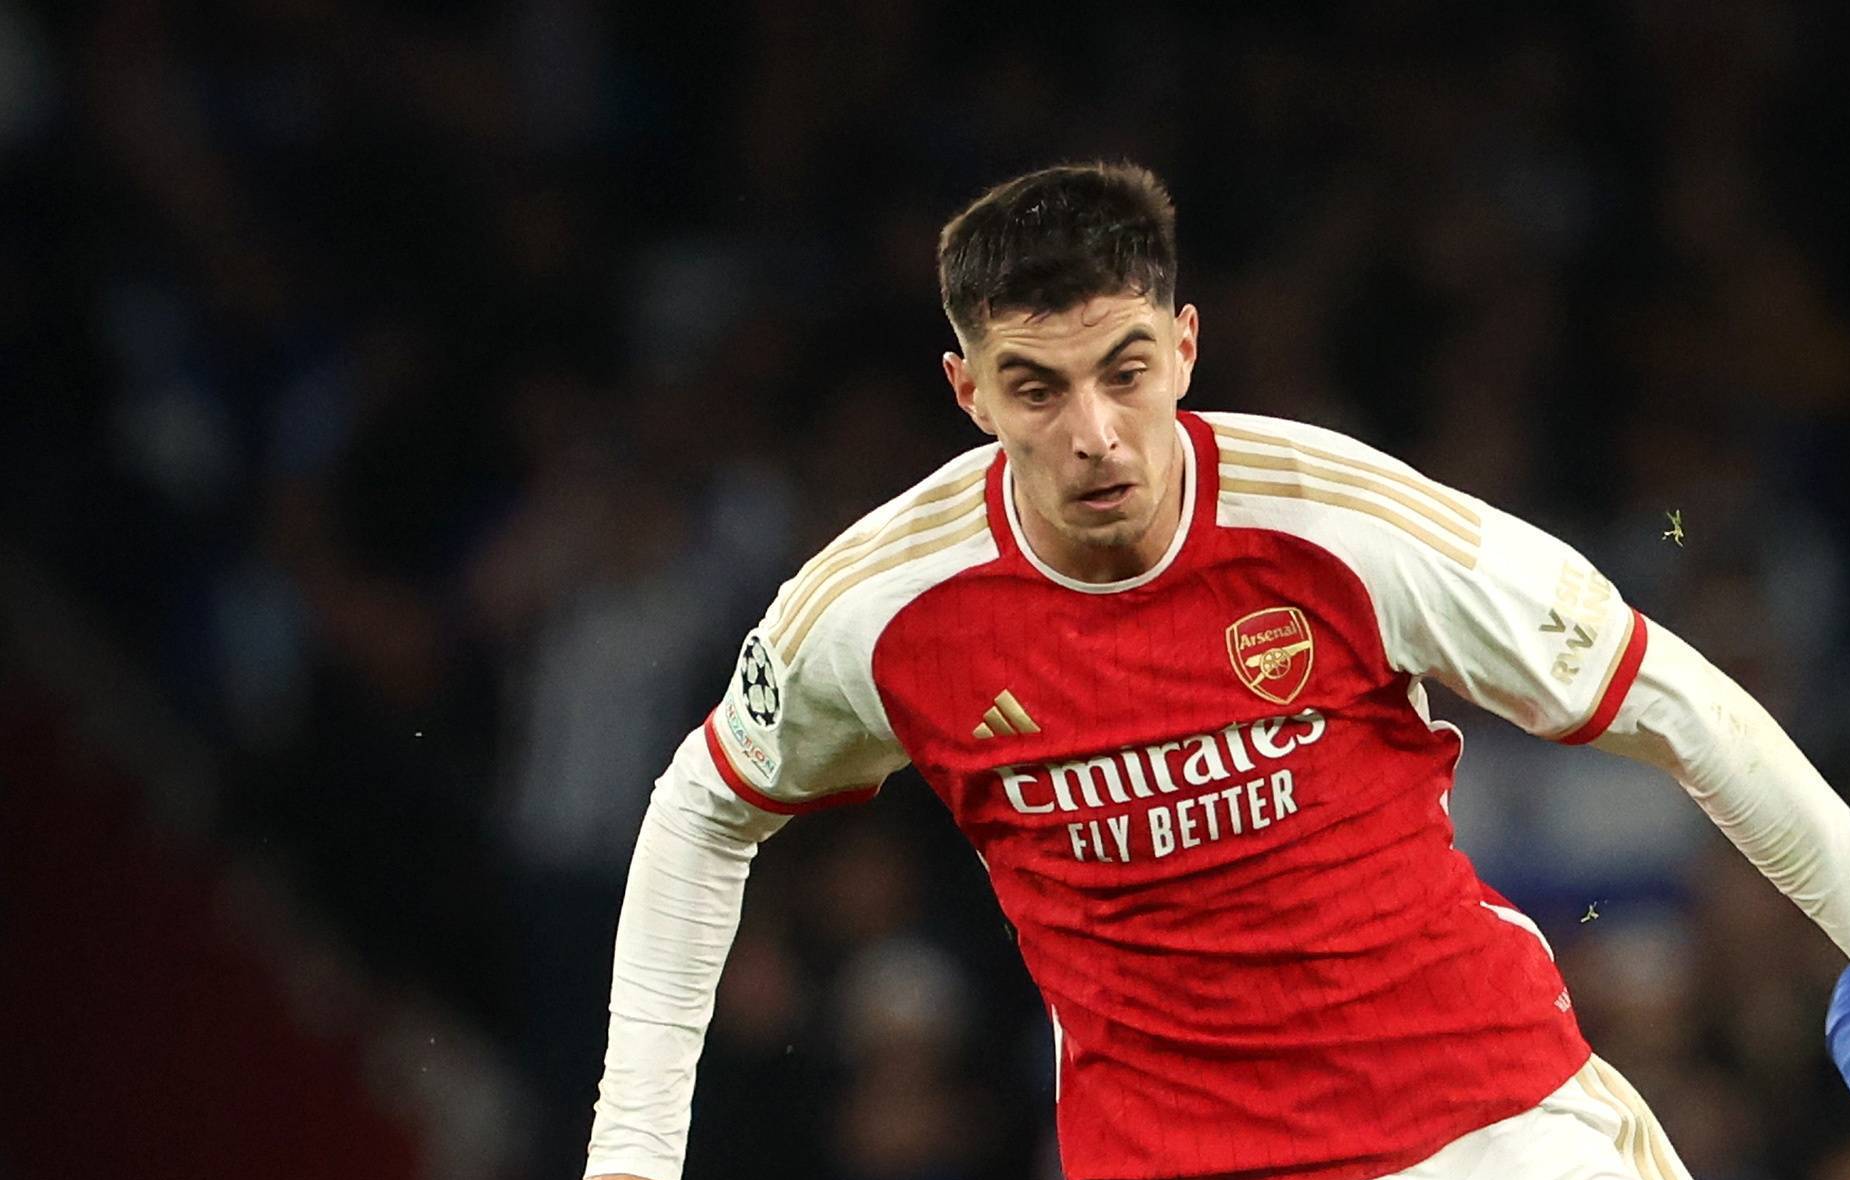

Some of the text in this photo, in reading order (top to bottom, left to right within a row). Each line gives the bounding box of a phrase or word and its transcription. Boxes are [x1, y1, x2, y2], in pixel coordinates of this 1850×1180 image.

[1239, 620, 1298, 650] Arsenal
[994, 708, 1328, 814] Emirates
[1067, 768, 1299, 863] FLY BETTER
